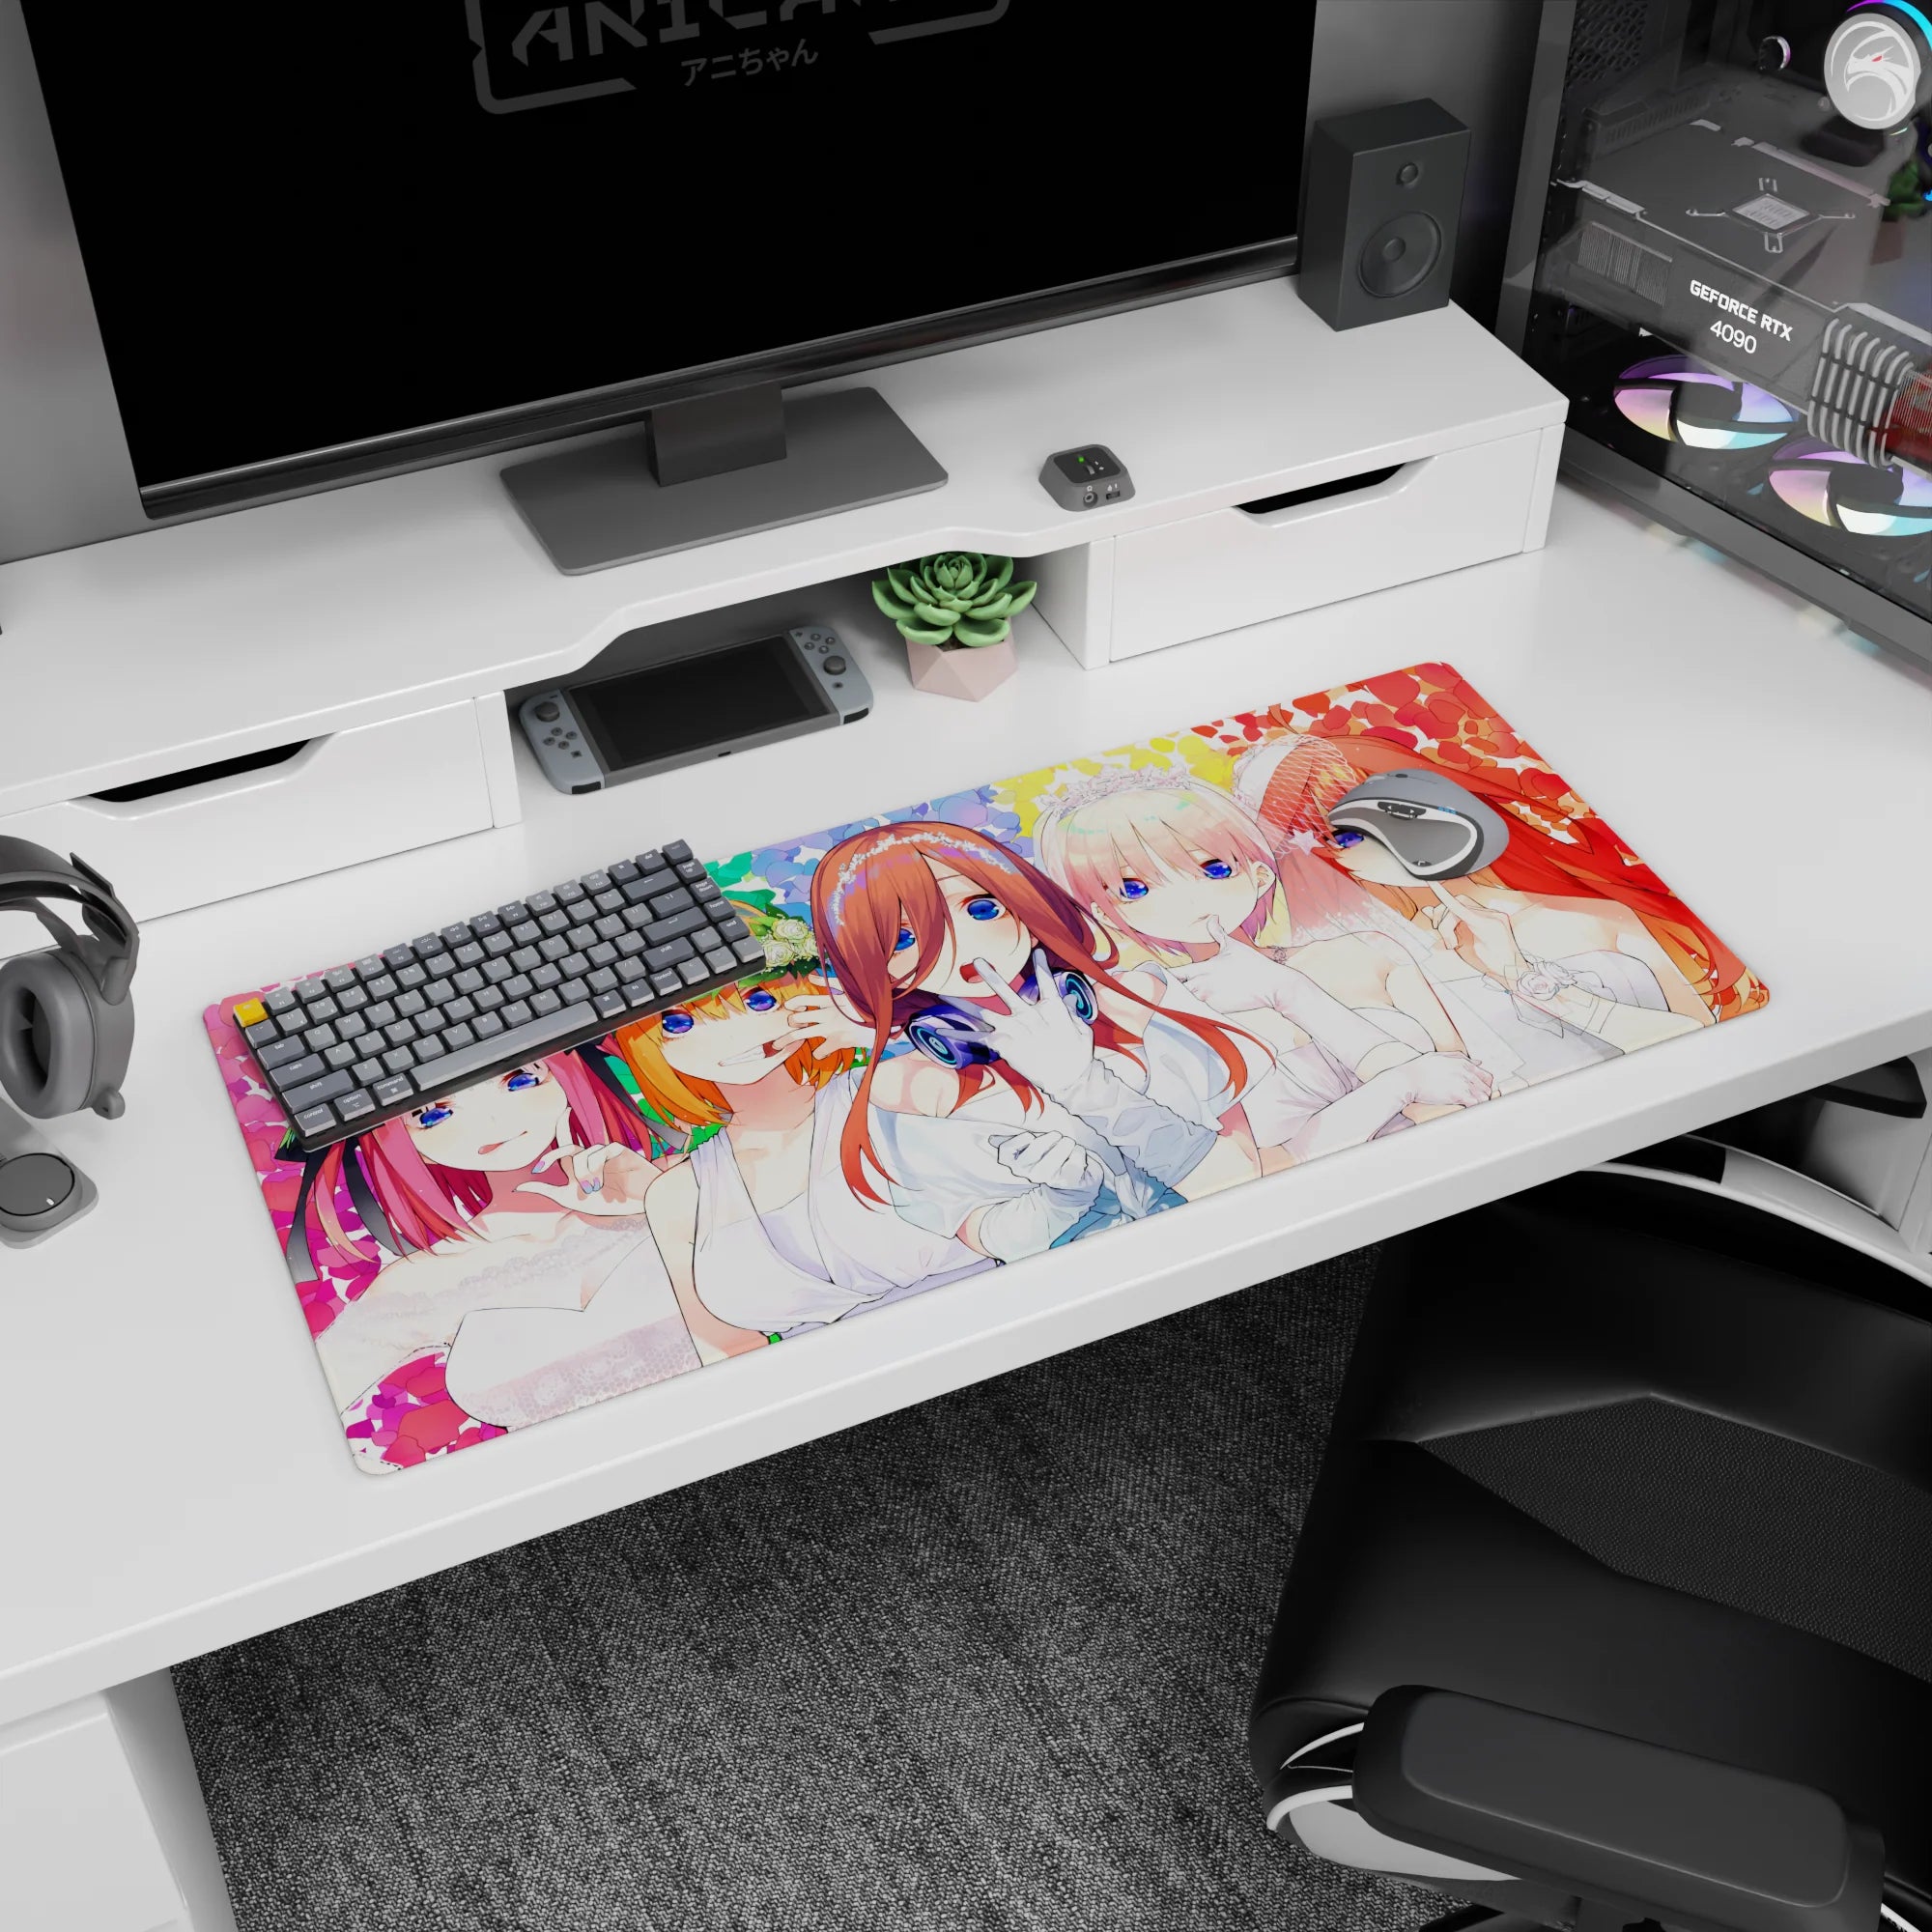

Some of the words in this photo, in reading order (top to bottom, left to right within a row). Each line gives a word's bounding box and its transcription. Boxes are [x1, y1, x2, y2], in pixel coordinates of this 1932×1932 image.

[681, 39, 819, 87] アニちゃん
[1690, 279, 1758, 325] GEFORCE
[1760, 314, 1793, 341] RTX
[1710, 320, 1756, 354] 4090
[654, 971, 672, 981] control
[377, 1076, 404, 1090] command
[343, 1094, 362, 1104] option
[303, 1108, 324, 1119] control
